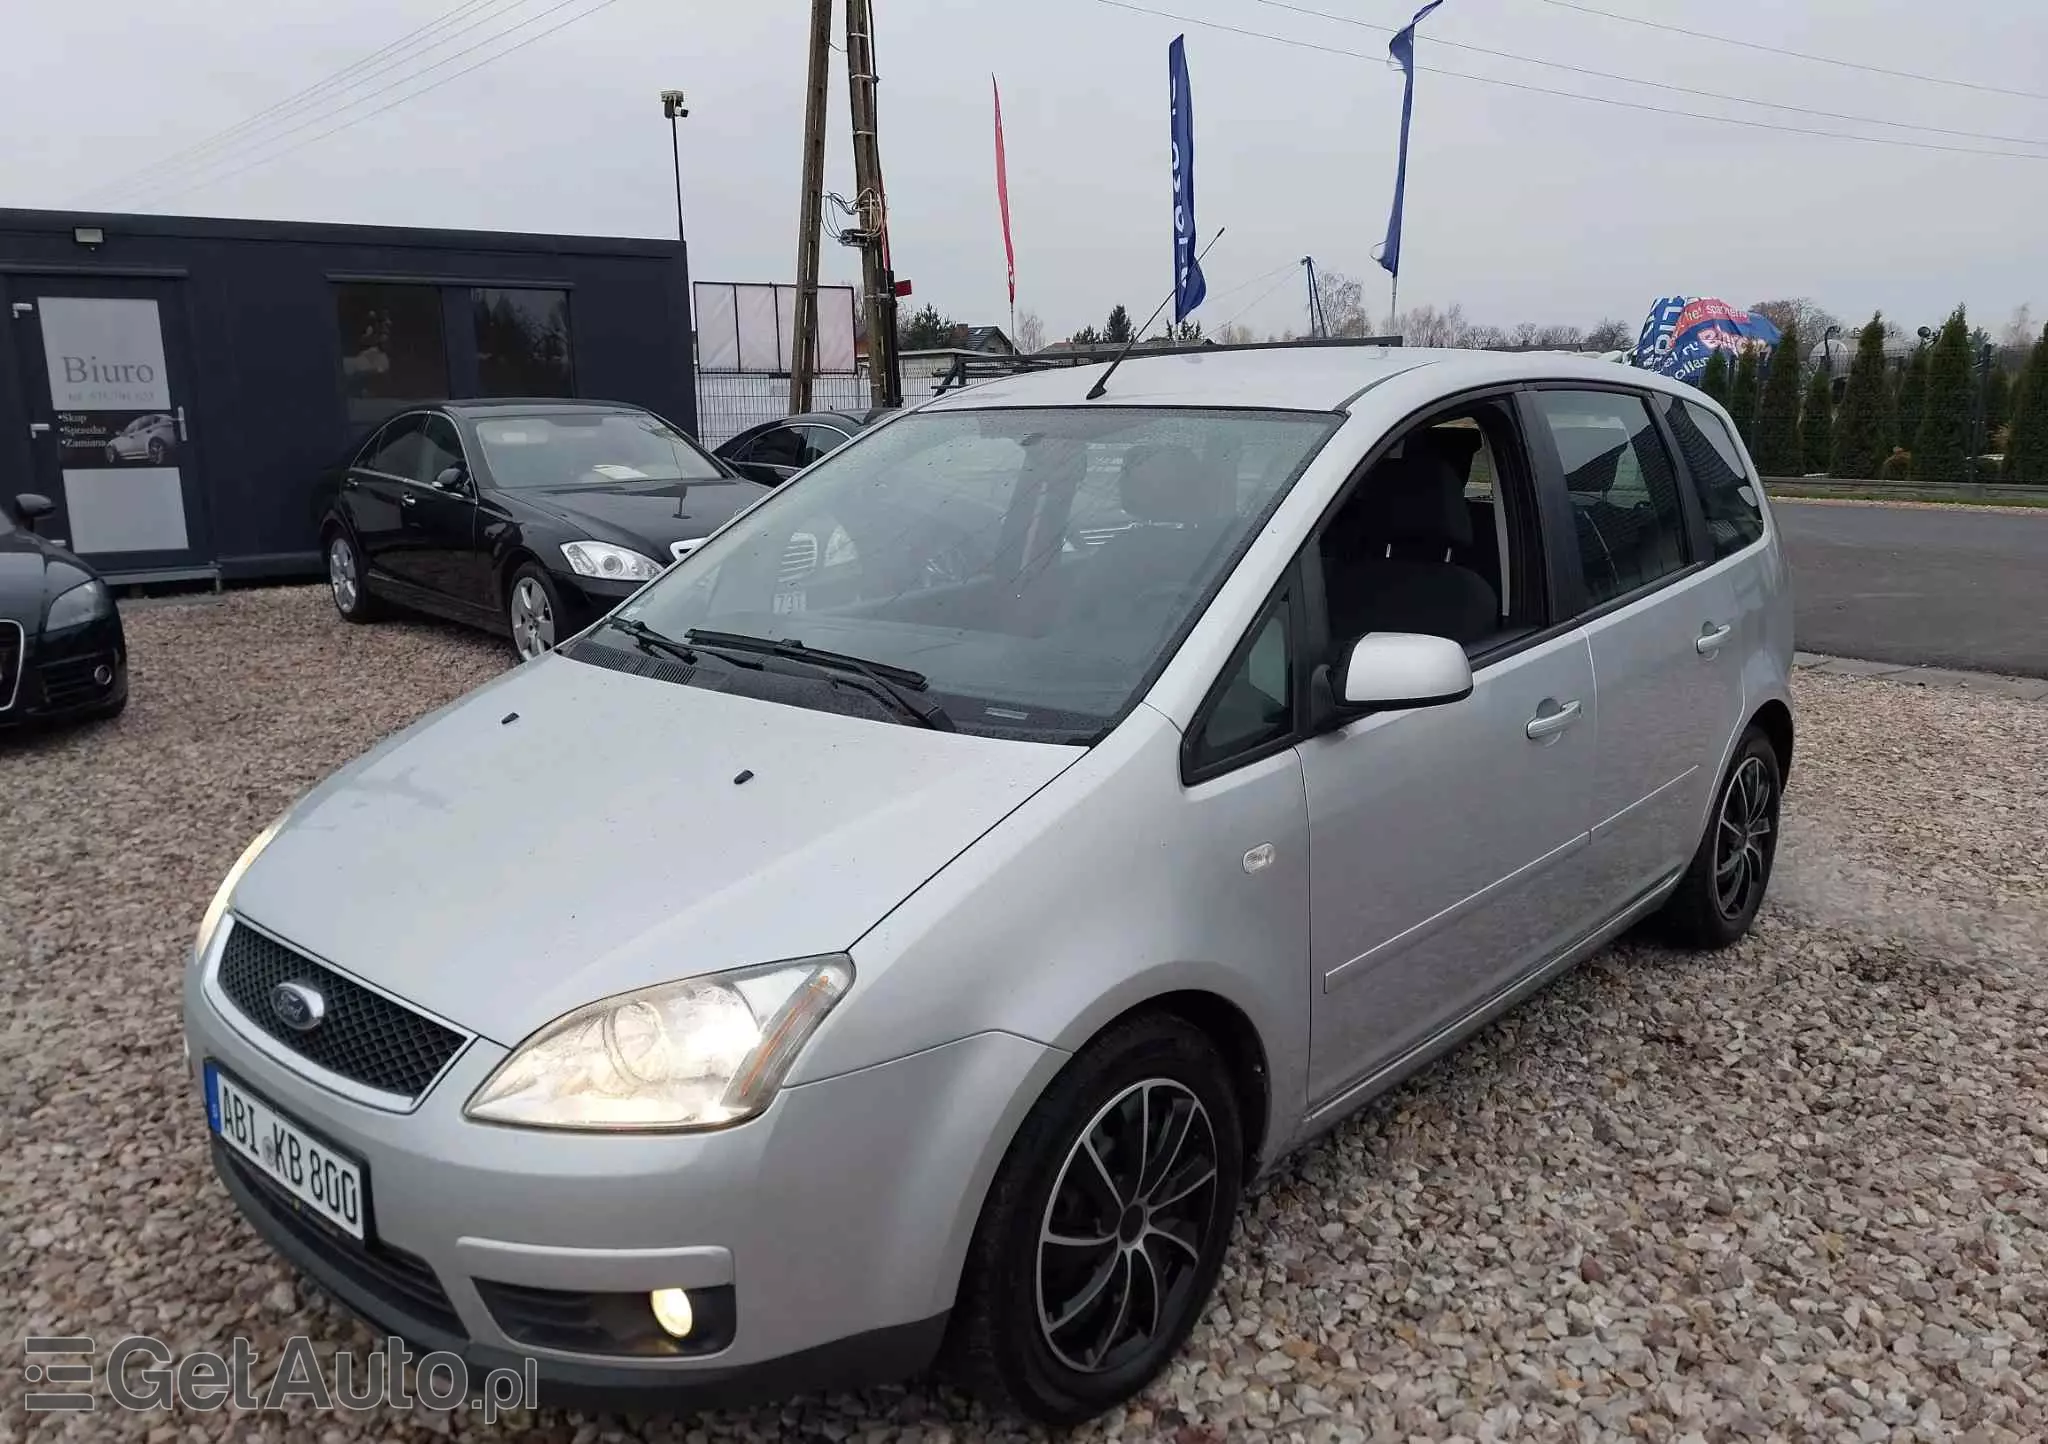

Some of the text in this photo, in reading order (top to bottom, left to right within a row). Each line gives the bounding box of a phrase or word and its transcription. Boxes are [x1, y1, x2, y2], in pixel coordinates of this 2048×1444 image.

[62, 356, 154, 383] Biuro
[223, 1085, 358, 1225] ABI KB 800
